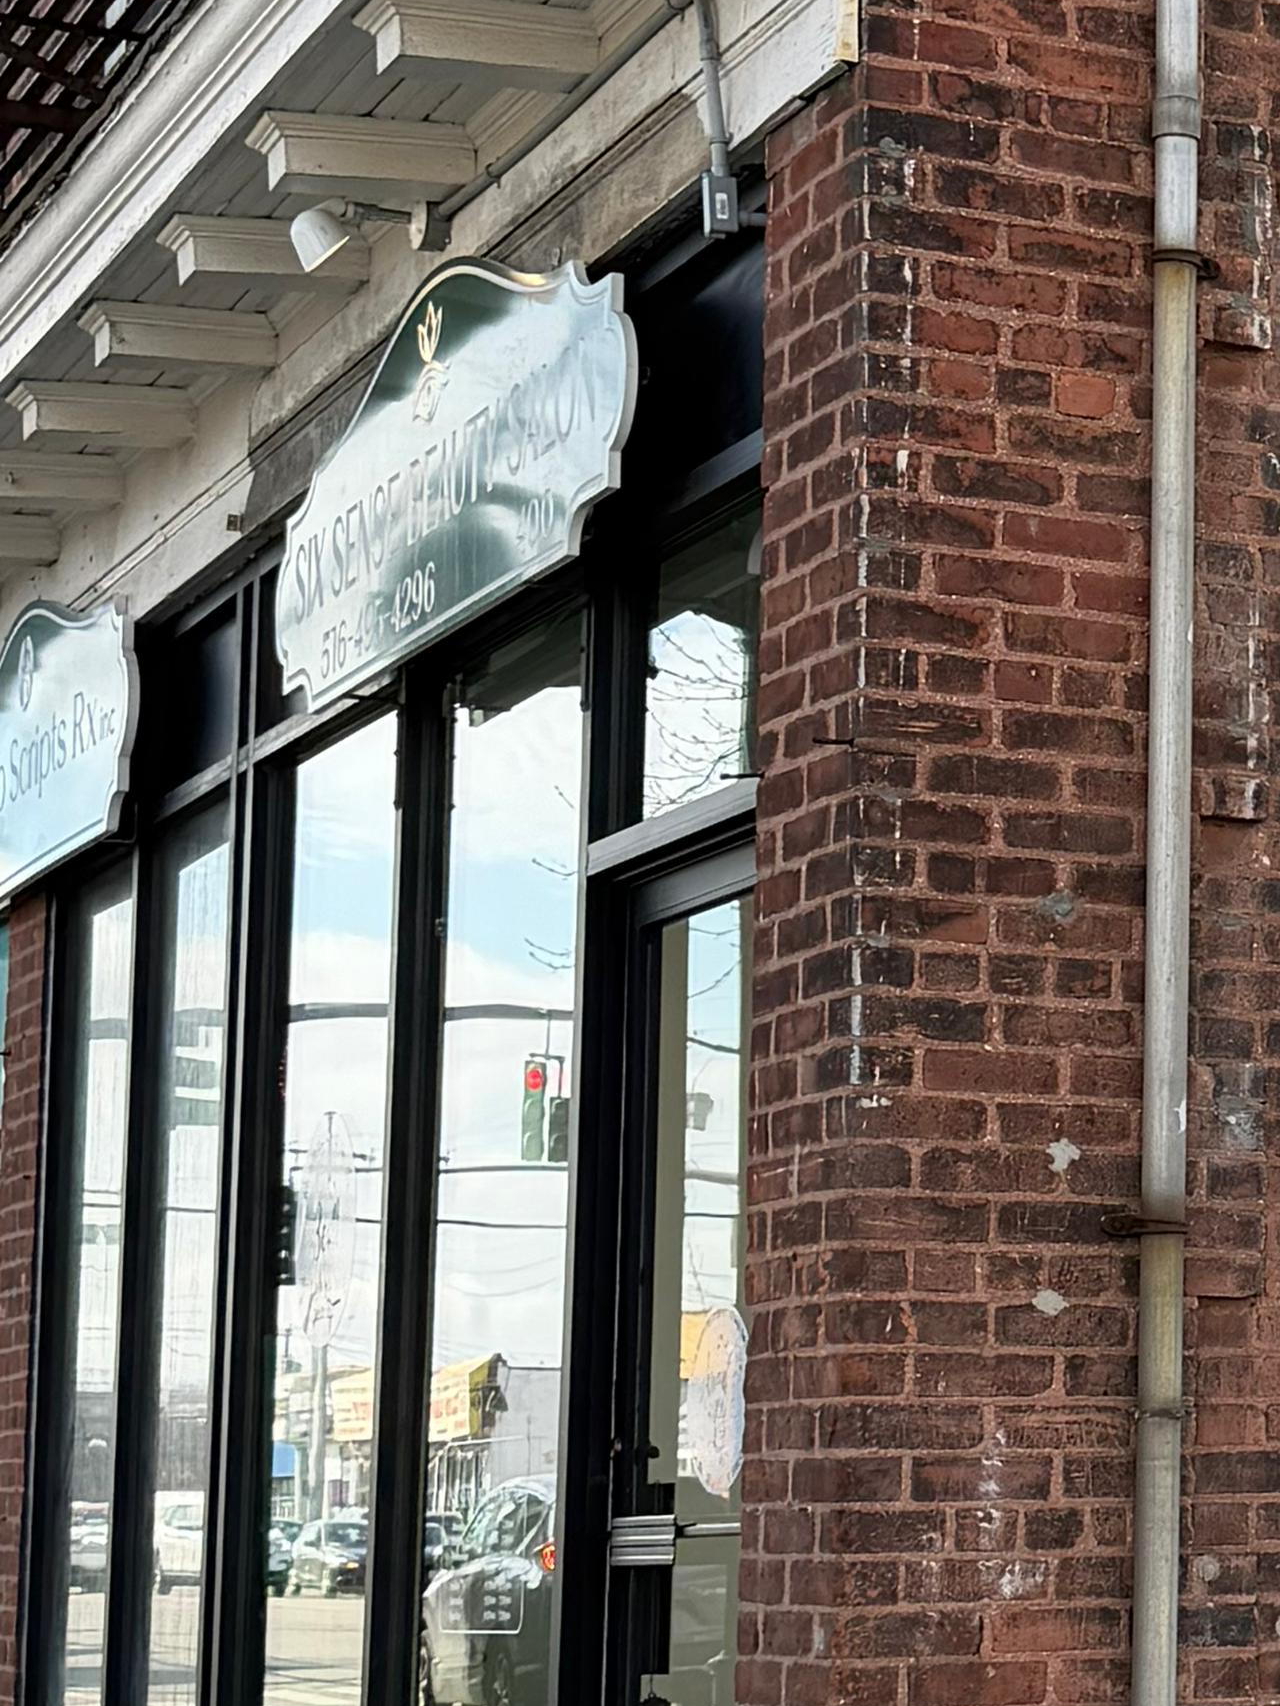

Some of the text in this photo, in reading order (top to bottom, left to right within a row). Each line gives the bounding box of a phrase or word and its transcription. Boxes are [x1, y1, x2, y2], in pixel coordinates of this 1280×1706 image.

[293, 527, 328, 624] SIX
[330, 467, 401, 598] SENSE
[407, 397, 499, 546] BEAUTY
[10, 712, 66, 802] Scripts
